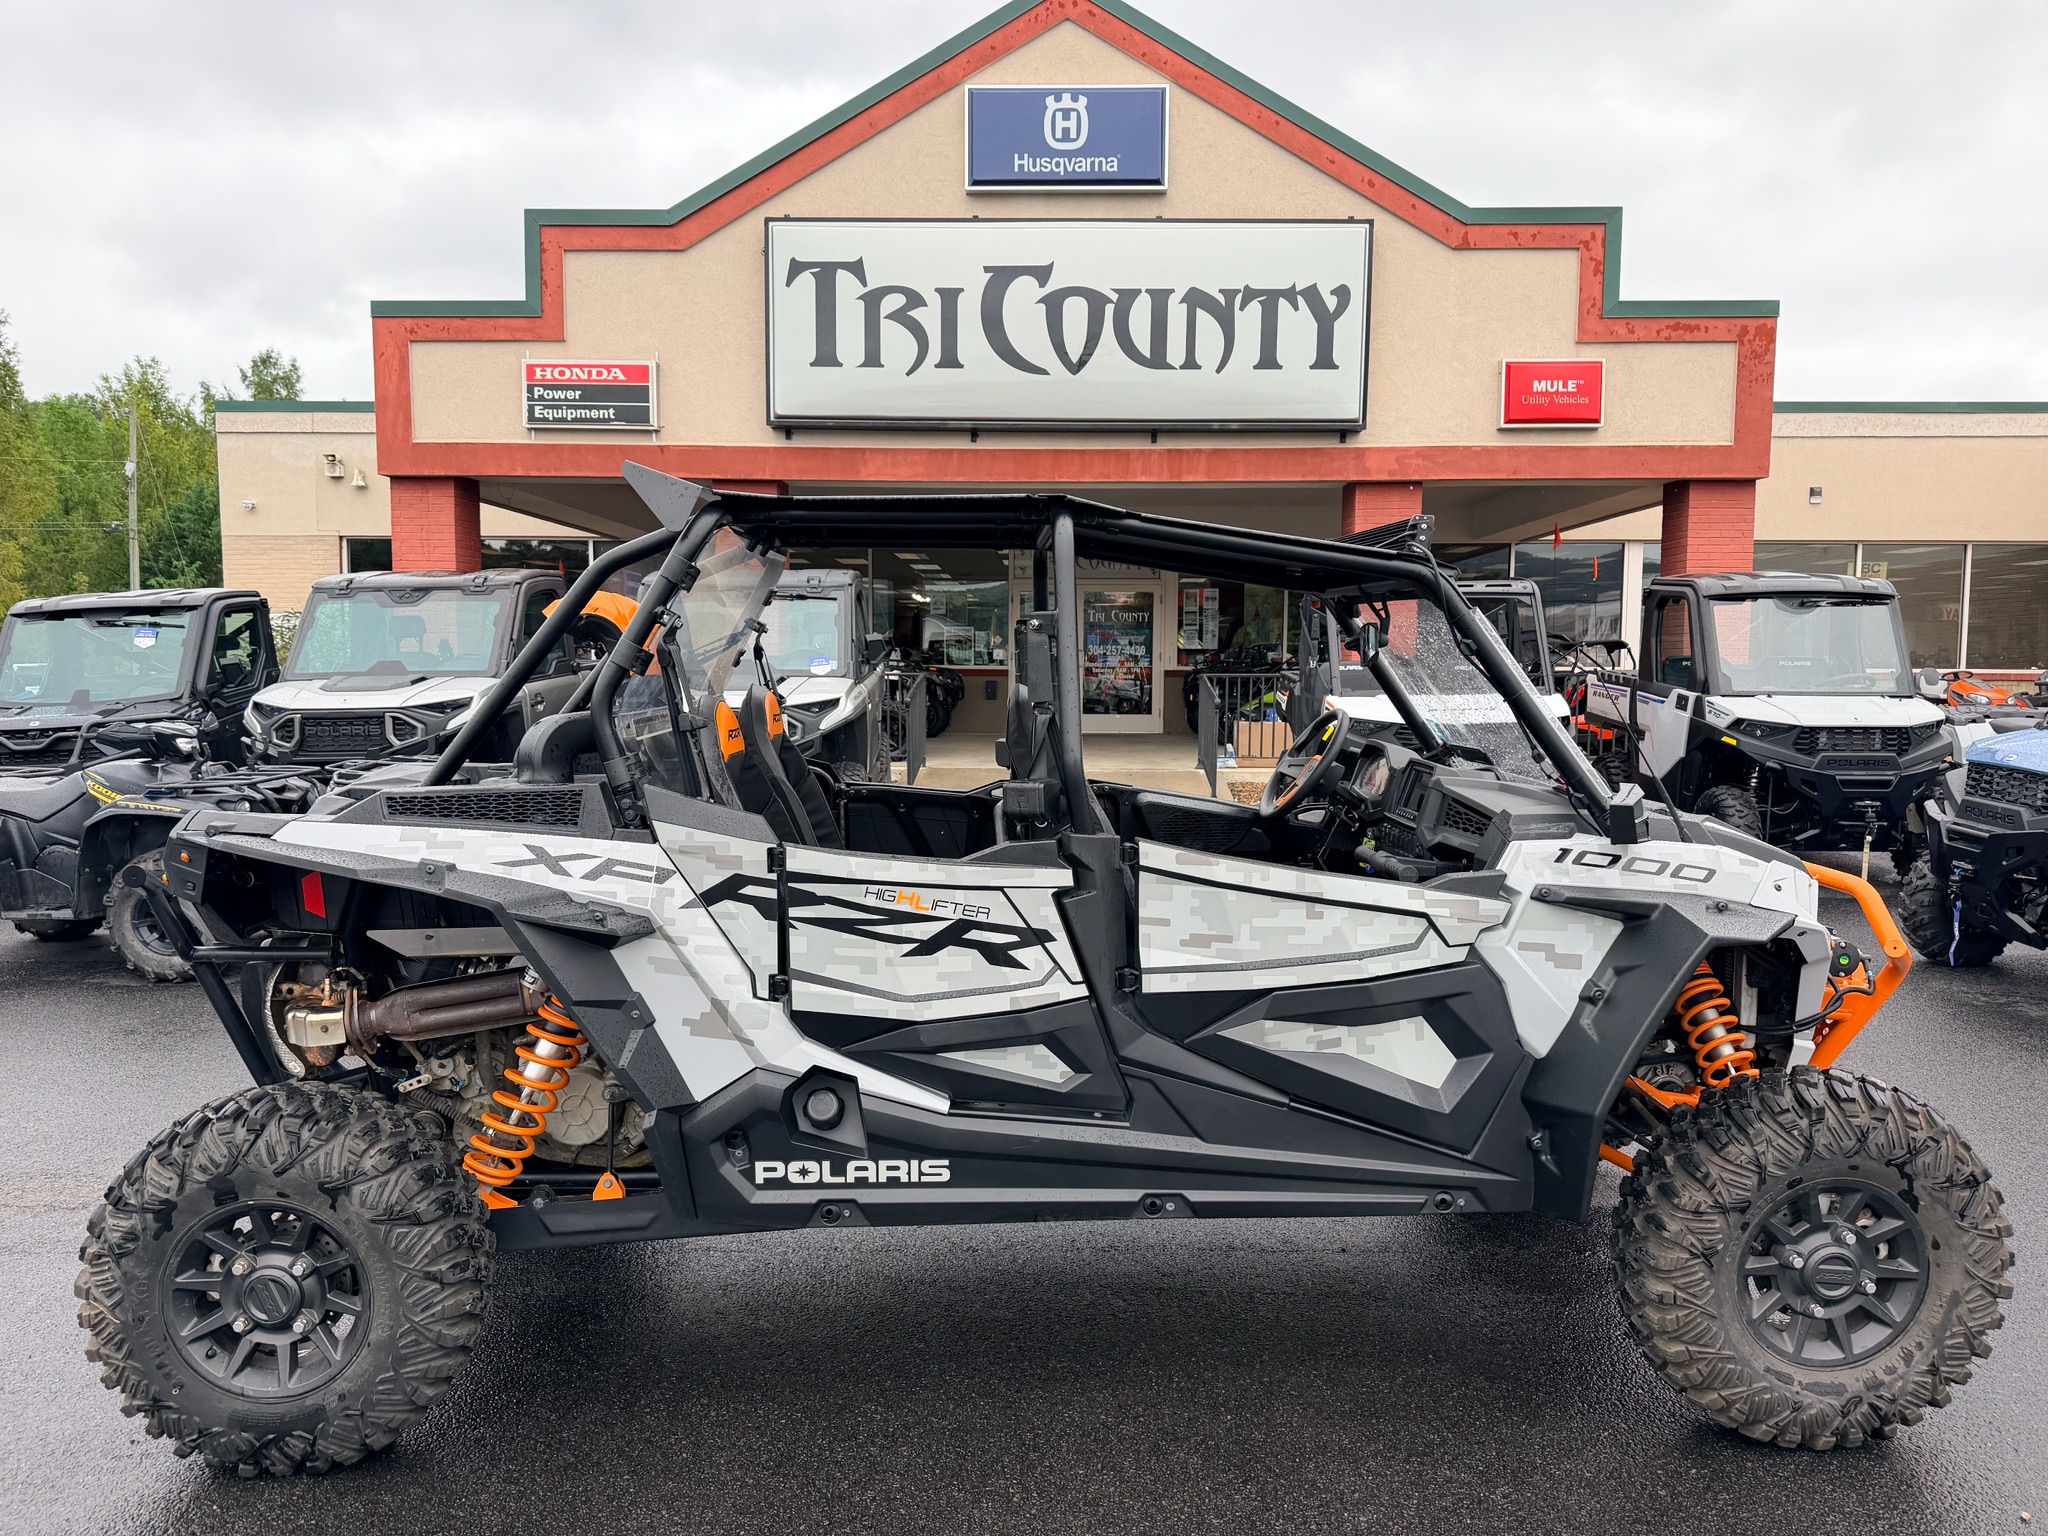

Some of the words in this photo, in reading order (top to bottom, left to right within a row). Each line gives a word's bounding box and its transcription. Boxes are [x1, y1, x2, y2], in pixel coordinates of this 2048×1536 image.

[1014, 153, 1118, 175] Husqvarna
[785, 256, 965, 377] TRI
[980, 260, 1352, 377] COUNTY
[533, 367, 627, 380] HONDA
[533, 387, 582, 399] Power
[1521, 395, 1550, 406] Utility
[1553, 395, 1589, 404] Vehicles
[534, 406, 616, 421] Equipment
[1087, 645, 1146, 656] 304-257-4420
[1592, 690, 1620, 701] RANGER
[303, 725, 381, 737] POLARIS
[1827, 759, 1890, 767] POLARIS
[1965, 804, 2015, 825] POLARIS
[1554, 848, 1717, 884] 1000
[755, 1159, 951, 1184] POLARIS
